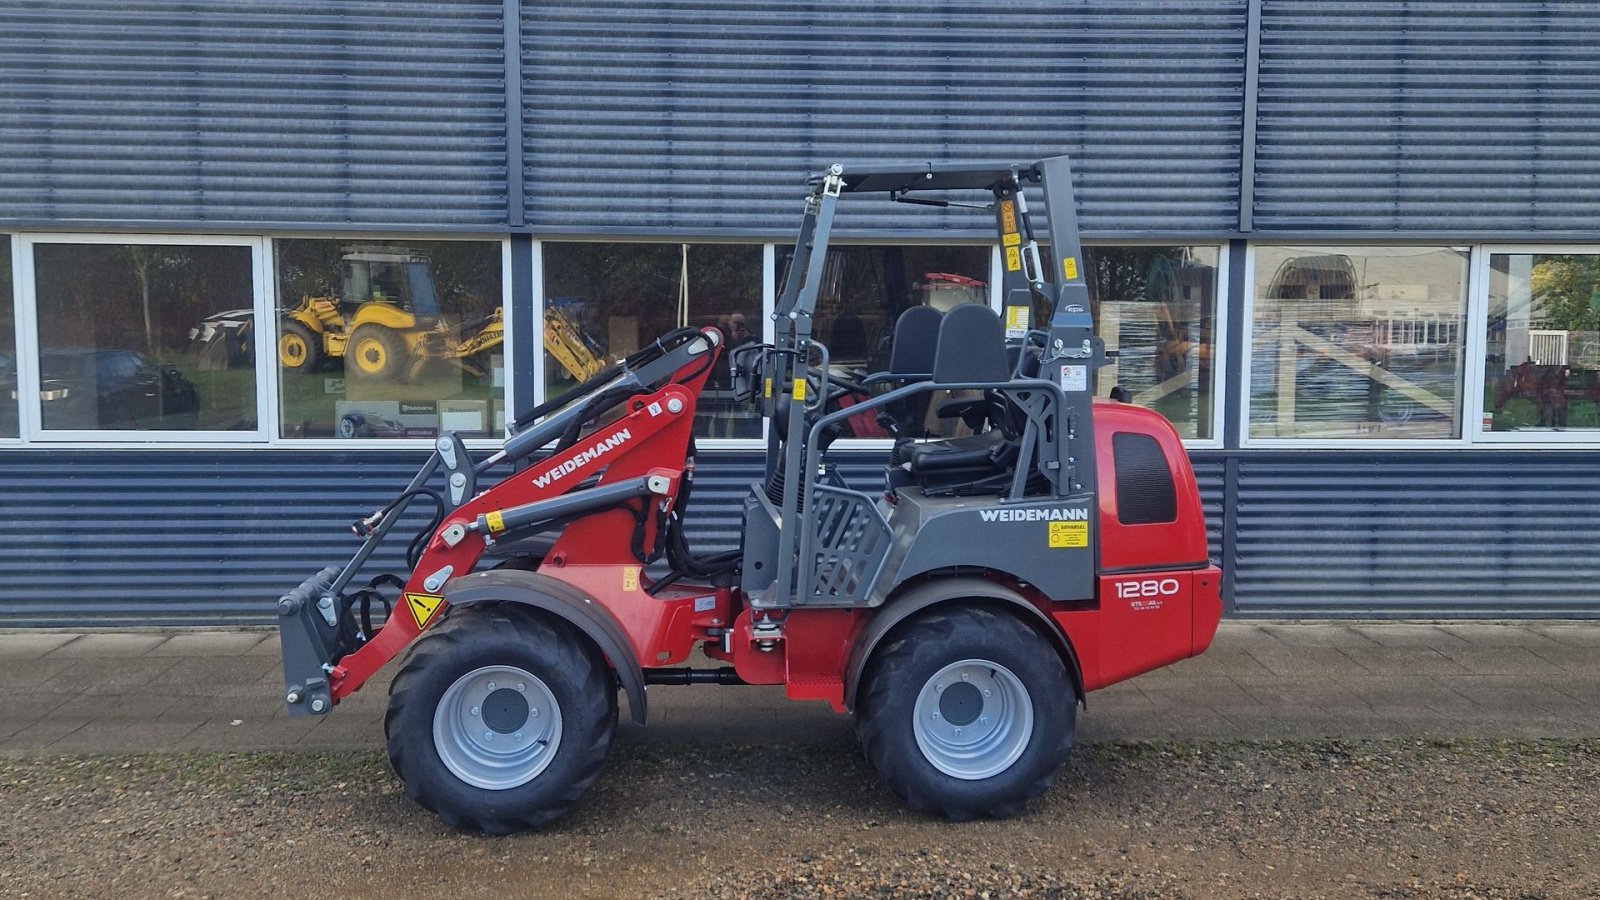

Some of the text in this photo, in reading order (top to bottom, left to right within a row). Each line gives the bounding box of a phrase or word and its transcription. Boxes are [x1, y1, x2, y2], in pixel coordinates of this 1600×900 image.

[532, 428, 632, 489] WEIDEMANN
[980, 508, 1088, 521] WEIDEMANN
[1115, 578, 1180, 598] 1280
